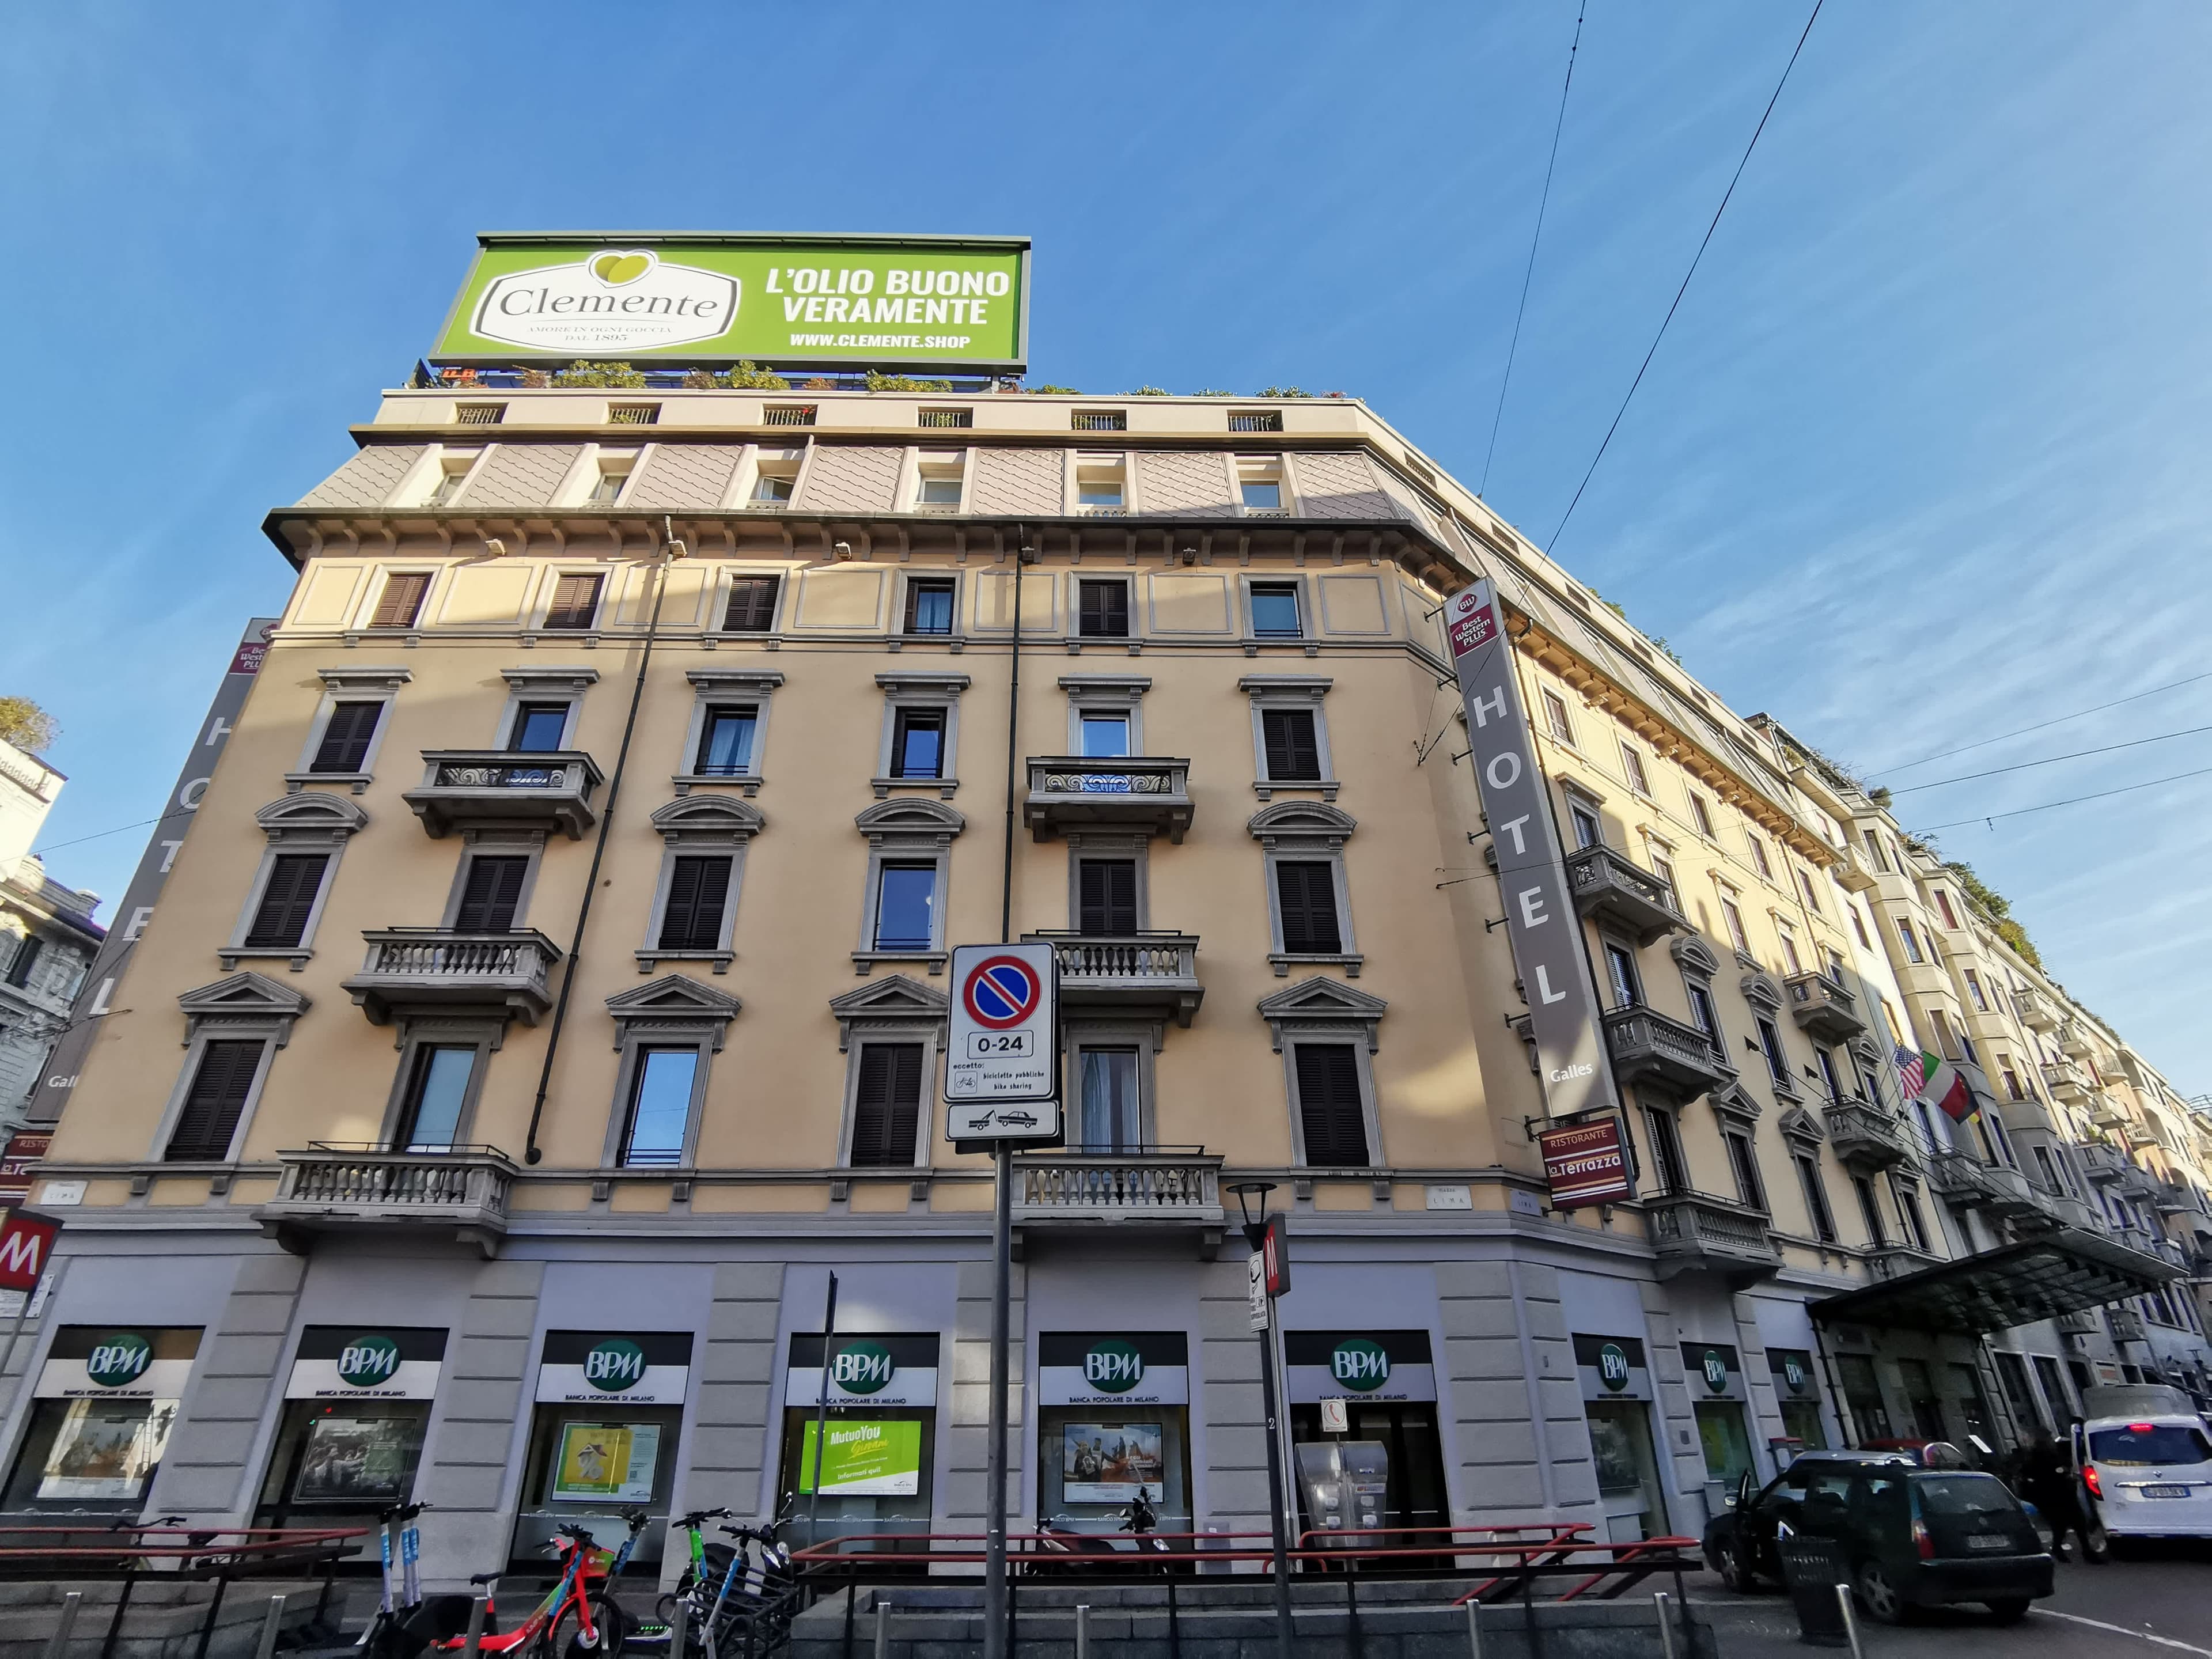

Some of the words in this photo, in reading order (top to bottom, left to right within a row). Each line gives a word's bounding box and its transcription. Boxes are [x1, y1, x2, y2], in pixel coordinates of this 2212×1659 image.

[766, 268, 874, 294] L'OLIO
[885, 270, 1009, 296] BUONO
[499, 287, 718, 317] Clemente
[783, 297, 988, 324] VERAMENTE
[790, 334, 971, 349] WWW.CLEMENTE.SHOP
[1459, 596, 1475, 611] BW
[1462, 616, 1482, 631] Best
[1463, 628, 1486, 646] PLUS
[1473, 685, 1566, 1005] HOTEL
[978, 1036, 1024, 1052] 0-24
[48, 1075, 79, 1088] Gall
[1015, 1070, 1044, 1080] pubbliche
[1550, 1063, 1593, 1083] Galles
[1009, 1082, 1032, 1090] sharing
[19, 1139, 49, 1148] RISTO
[1550, 1130, 1608, 1148] RISTORANTE
[1548, 1165, 1558, 1175] la
[1559, 1155, 1622, 1176] Terrazza
[0, 1231, 41, 1275] M
[1267, 1236, 1278, 1281] M
[88, 1346, 150, 1373] BPM
[339, 1347, 397, 1374] BPM
[586, 1351, 642, 1379] BPM
[835, 1354, 891, 1381] BPM
[1086, 1353, 1141, 1381] BPM
[1334, 1351, 1388, 1378] BPM
[1601, 1354, 1629, 1378] BPM
[1268, 1418, 1275, 1430] 2
[838, 1469, 867, 1480] Informati
